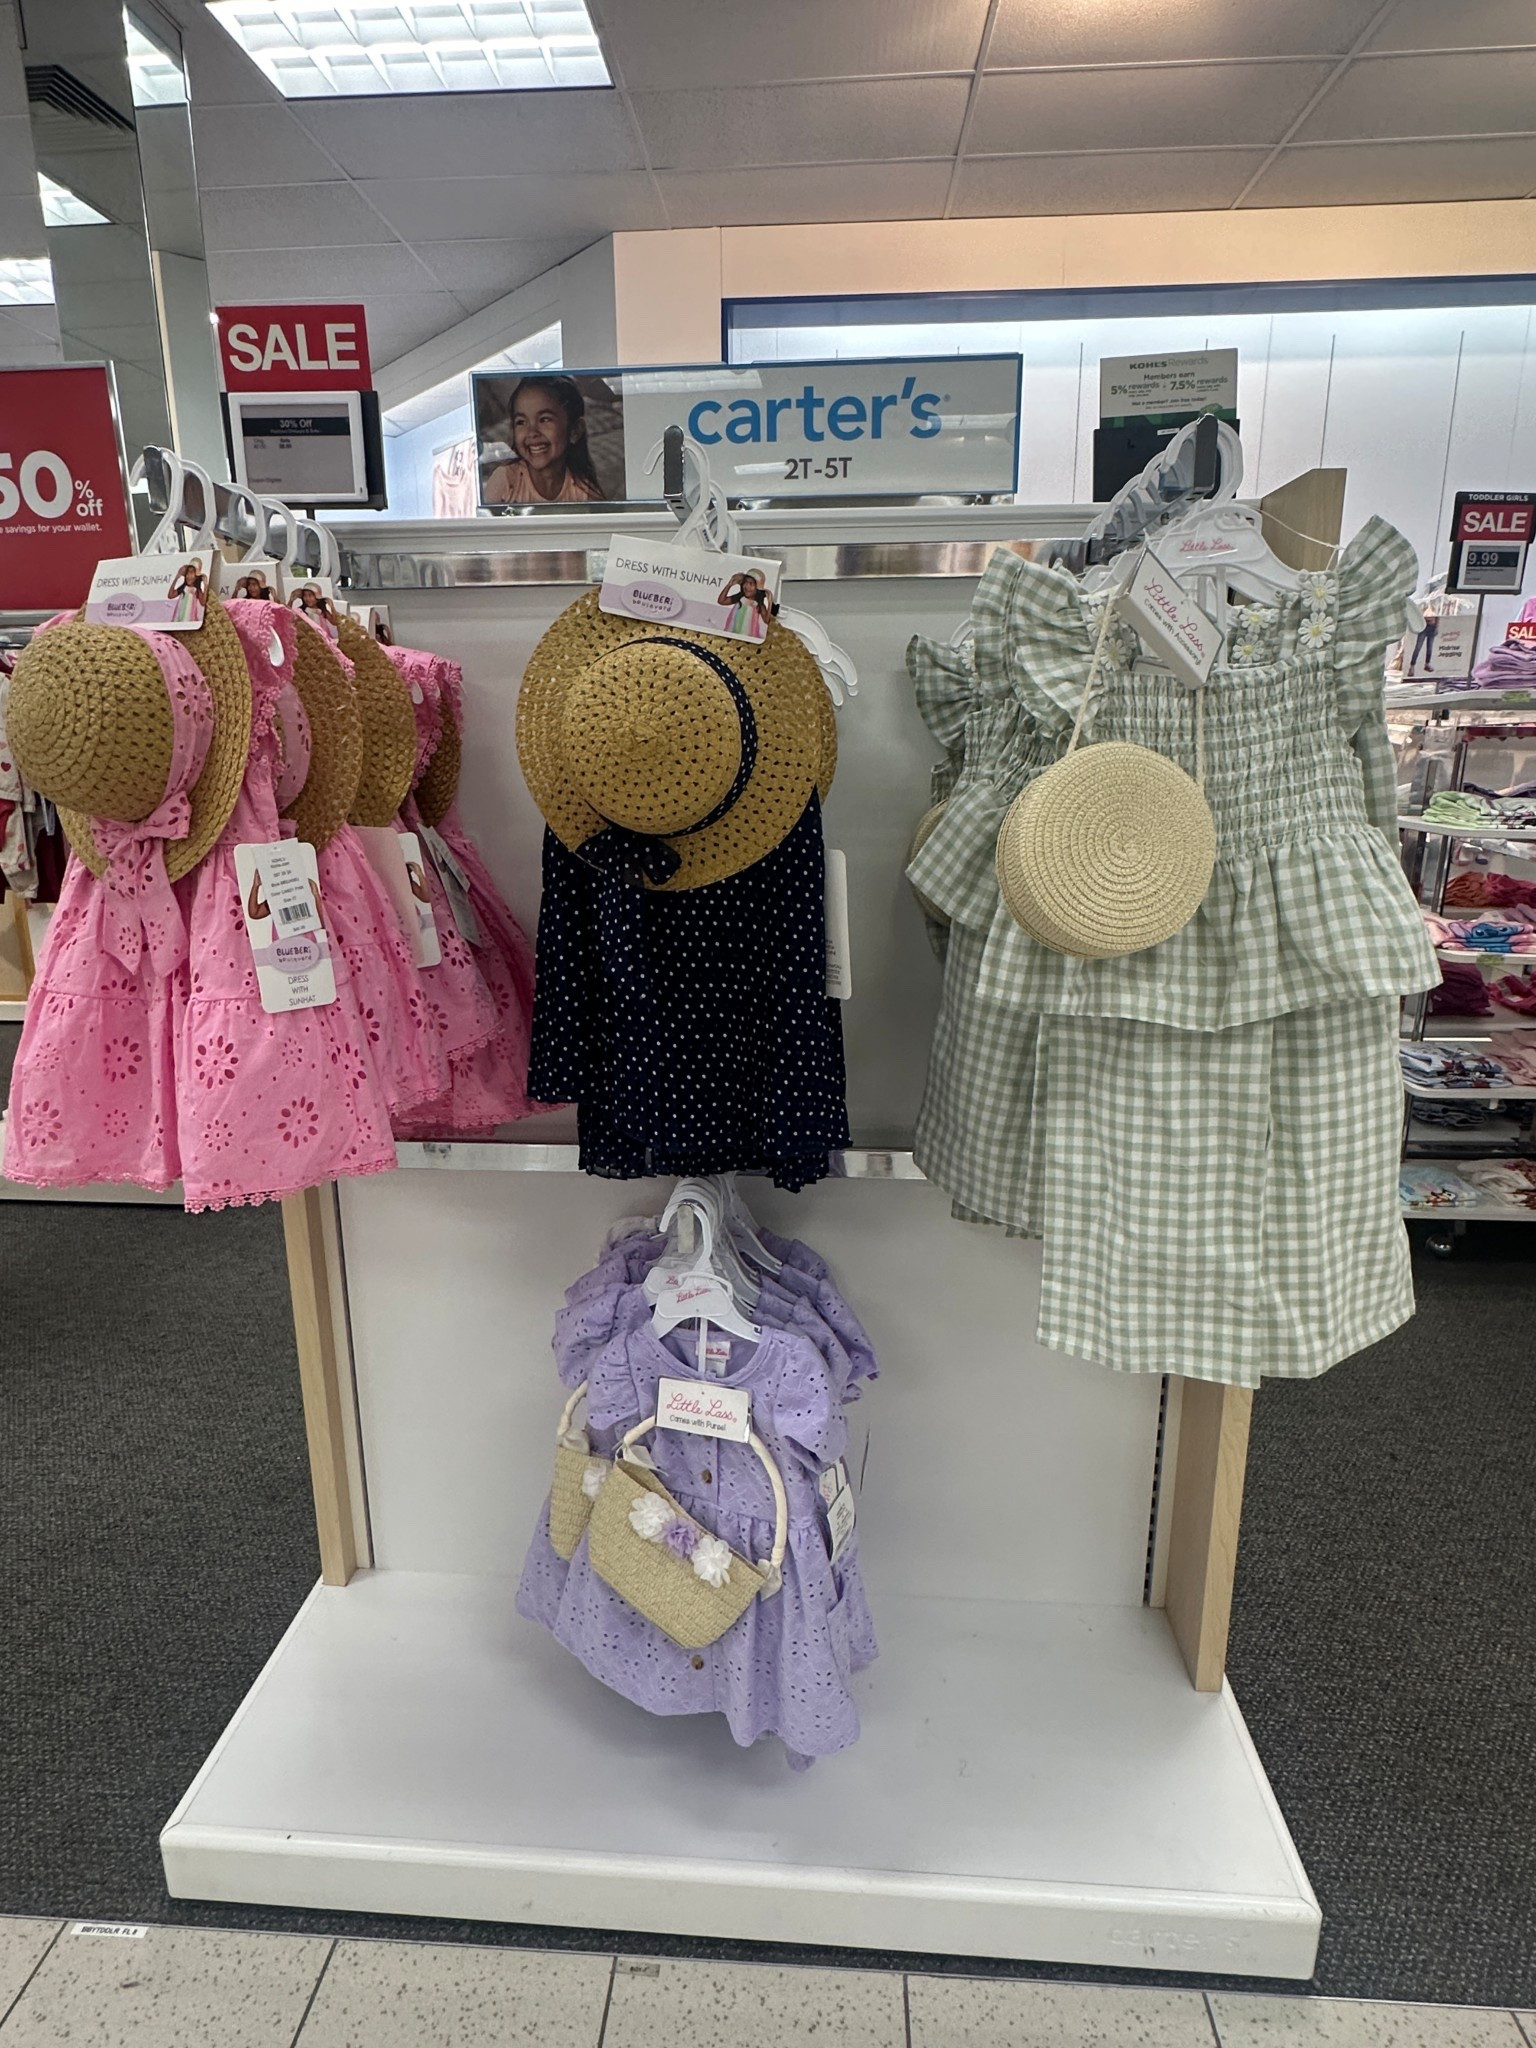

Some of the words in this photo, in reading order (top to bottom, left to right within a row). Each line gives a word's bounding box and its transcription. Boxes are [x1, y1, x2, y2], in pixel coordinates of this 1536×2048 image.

[227, 323, 360, 372] SALE
[1129, 361, 1167, 370] KOHL'S
[1167, 356, 1209, 367] Rewards
[1144, 373, 1177, 381] Members
[1169, 380, 1196, 391] 7.5%
[1196, 376, 1228, 385] rewards
[1111, 385, 1128, 395] 5%
[1128, 382, 1159, 390] rewards
[688, 376, 943, 446] carter's
[279, 419, 298, 428] 30%
[299, 418, 313, 428] Off
[784, 456, 852, 480] 2T-5T
[74, 480, 94, 499] %
[1468, 493, 1505, 501] TODDLER
[76, 499, 103, 517] off
[5, 524, 36, 534] savings
[37, 523, 50, 533] for
[51, 523, 72, 534] your
[74, 522, 103, 532] wallet.
[1463, 511, 1529, 533] SALE
[1468, 552, 1499, 565] 9.99
[616, 557, 649, 574] DRESS
[652, 565, 678, 579] WITH
[679, 570, 724, 588] SUNHAT
[96, 577, 120, 588] DRESS
[121, 576, 141, 587] WITH
[140, 573, 173, 586] SUNHAT
[1144, 577, 1178, 623] Little
[1179, 616, 1204, 652] Lass
[1144, 598, 1163, 622] Comes
[1162, 620, 1175, 635] with
[1508, 626, 1536, 640] SAL
[287, 975, 310, 985] DRESS
[291, 985, 309, 995] WITH
[288, 995, 316, 1007] SUNHAT
[666, 1392, 703, 1415] Little
[704, 1398, 733, 1421] Lass
[669, 1414, 690, 1425] Comes
[691, 1419, 705, 1428] with
